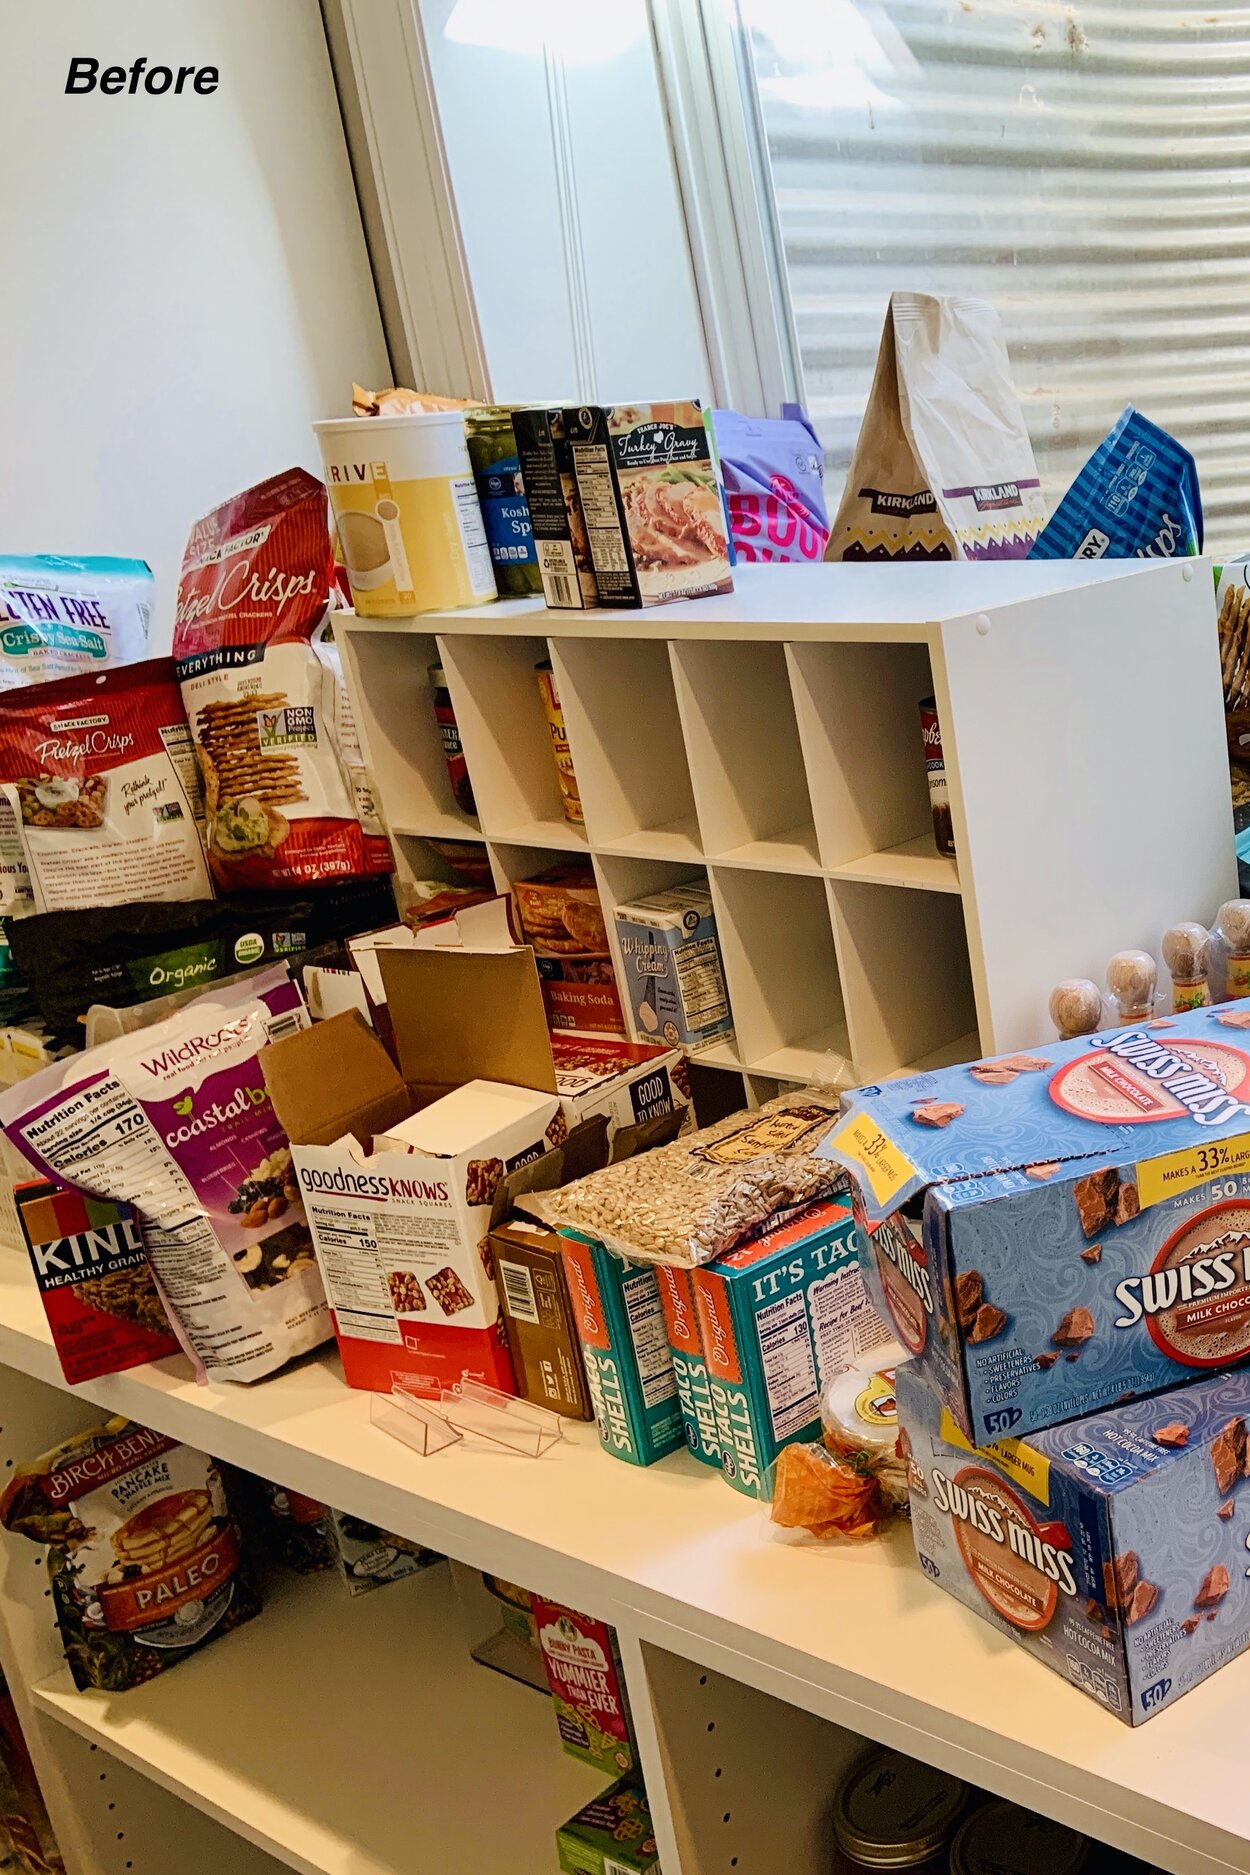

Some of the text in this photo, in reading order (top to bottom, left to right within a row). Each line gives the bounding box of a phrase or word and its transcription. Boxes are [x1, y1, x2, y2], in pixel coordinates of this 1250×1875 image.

[618, 431, 698, 463] Turkey Gravy
[877, 492, 934, 508] KIRKLAND
[218, 560, 317, 616] Crisps
[60, 596, 111, 629] FREE
[56, 632, 104, 651] Sea Salt
[176, 649, 257, 678] EVERYTHING
[190, 680, 207, 692] DELI
[287, 705, 313, 718] NON
[262, 733, 316, 748] VERIFIED
[621, 937, 669, 960] Whipping
[149, 956, 217, 988] Organic
[636, 957, 665, 974] Cream
[550, 990, 615, 1006] Baking Soda
[1090, 1031, 1193, 1080] SWISS
[638, 1076, 664, 1106] GOOD
[1099, 1065, 1155, 1107] MILK CHOCOLATE
[26, 1079, 121, 1140] Nutrition Facts
[53, 1113, 145, 1169] Calories 170
[1163, 1168, 1190, 1182] MAKES
[1190, 1165, 1197, 1174] A
[1197, 1147, 1230, 1172] 33%
[418, 1199, 453, 1208] SQUARES
[1210, 1180, 1238, 1201] 50
[359, 1237, 378, 1250] 150
[44, 1263, 105, 1289] HEALTHY
[751, 1260, 805, 1303] IT'S
[812, 1275, 839, 1296] Warming
[1113, 1251, 1236, 1328] SWISS
[566, 1254, 600, 1335] Original
[1188, 1293, 1221, 1308] PREMIUM
[794, 1322, 808, 1336] 130
[818, 1303, 864, 1332] Recipe for Beef
[1186, 1306, 1213, 1324] MILK
[987, 1348, 1026, 1365] ARTIFICIAL
[988, 1355, 1033, 1374] SWEETENERS
[583, 1351, 609, 1414] TACO
[989, 1362, 1042, 1383] PRESERVATIVES
[990, 1379, 1022, 1394] FLAVORS
[600, 1353, 633, 1454] SHELLS
[991, 1389, 1019, 1404] COLORS
[727, 1391, 761, 1491] SHELLS
[50, 1448, 115, 1500] BIRCH
[111, 1461, 169, 1500] PANCAKE
[930, 1466, 1006, 1545] SWISS
[135, 1552, 220, 1610] PALEO
[994, 1572, 1038, 1609] CHOCOLATE
[546, 1636, 598, 1662] BUNNY PASTA
[547, 1656, 611, 1696] YUMMIER
[565, 1683, 620, 1716] THAN EVER
